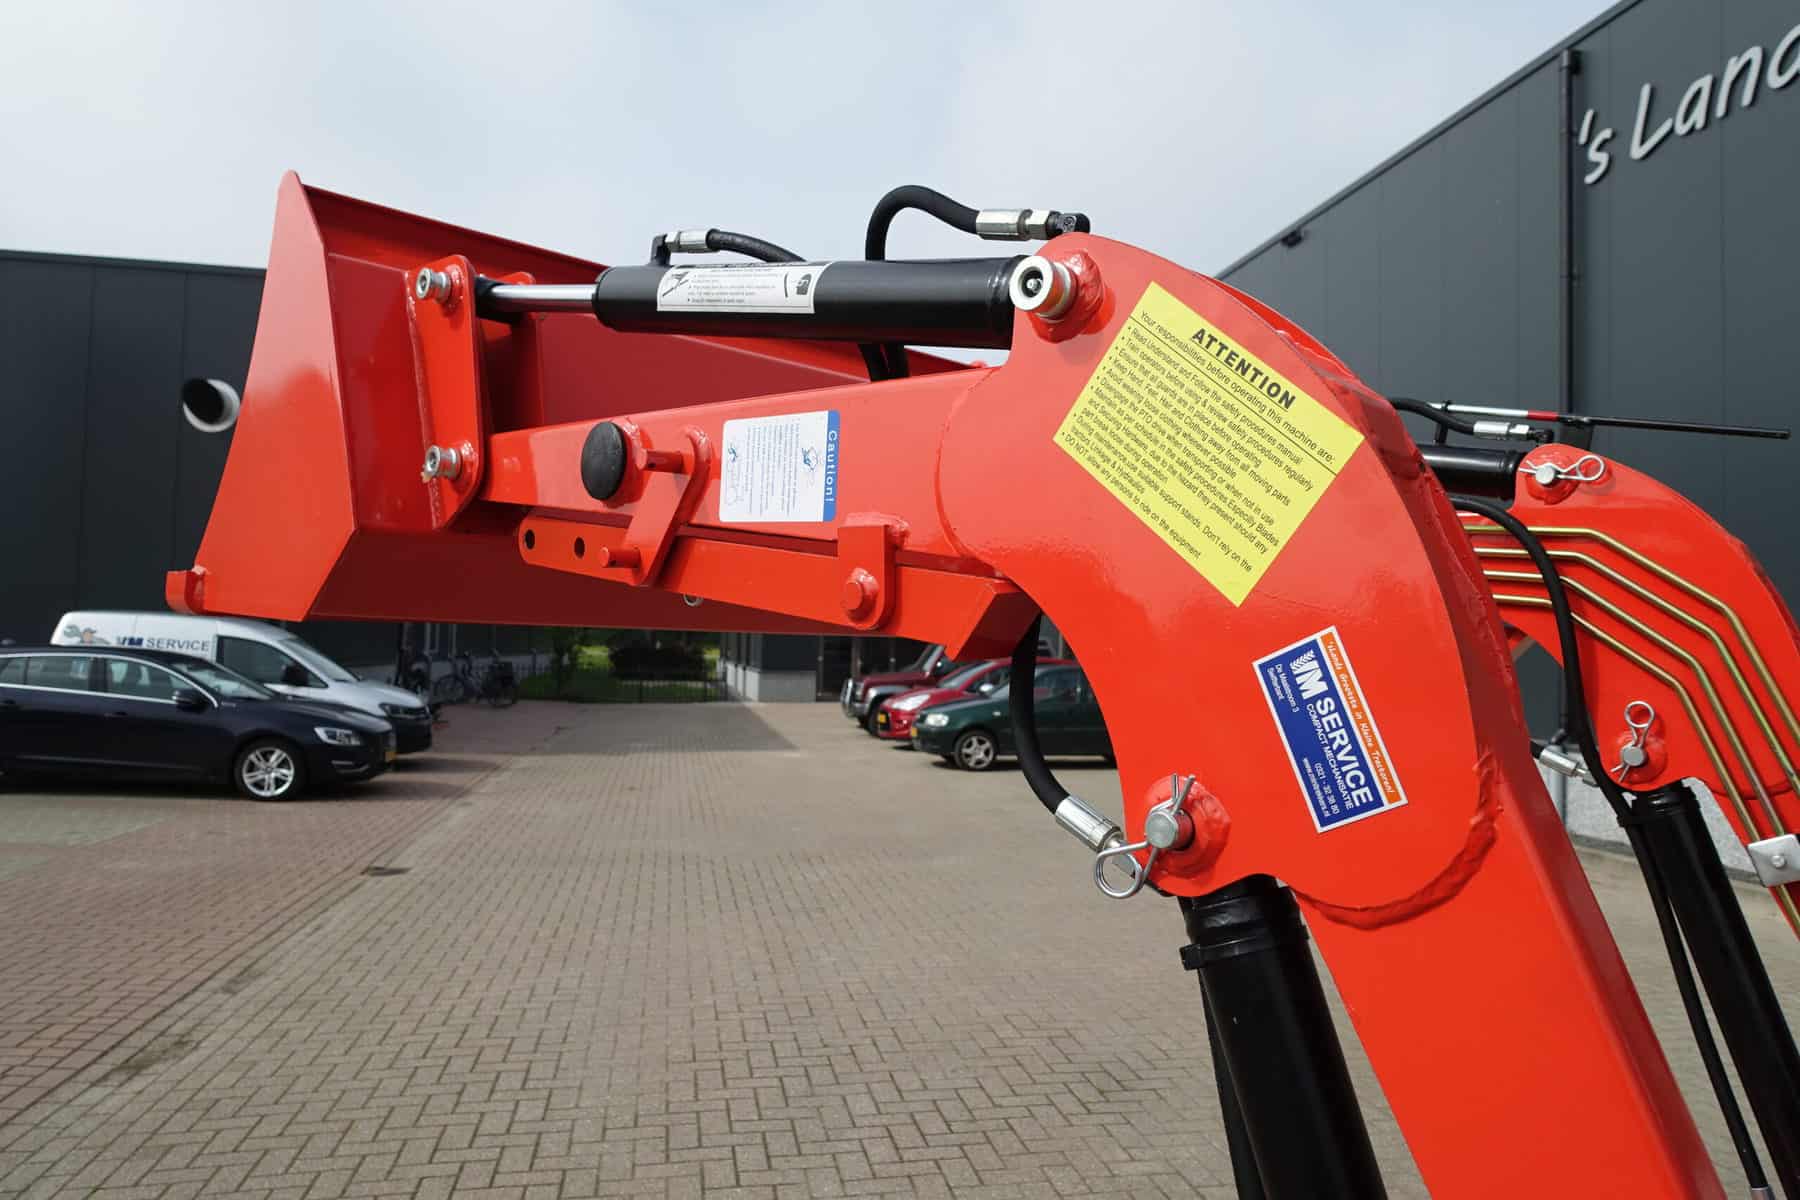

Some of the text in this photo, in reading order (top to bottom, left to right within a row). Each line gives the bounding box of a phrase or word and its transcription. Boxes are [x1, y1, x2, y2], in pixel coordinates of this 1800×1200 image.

[1578, 108, 1614, 185] 's
[1140, 310, 1156, 326] Your
[1155, 324, 1206, 366] responsibilities
[1205, 361, 1231, 384] before
[1230, 381, 1267, 414] operating
[1266, 408, 1282, 424] this
[1282, 421, 1317, 450] machine
[1192, 328, 1295, 409] ATTENTION
[1128, 401, 1139, 413] the
[1137, 408, 1153, 424] PTO
[1151, 421, 1166, 436] drive
[1182, 445, 1218, 480] transporting
[1241, 496, 1255, 509] not
[1260, 513, 1274, 526] use
[1139, 351, 1166, 375] operators
[1165, 371, 1185, 390] before
[1207, 404, 1228, 423] review
[1227, 420, 1248, 440] safety
[1245, 436, 1283, 468] procedures
[1283, 464, 1313, 492] regularly
[1143, 397, 1159, 415] loose
[1158, 412, 1182, 436] clothing
[1181, 431, 1211, 457] whenever
[1209, 454, 1237, 479] possible
[1149, 374, 1159, 383] all
[1155, 380, 1178, 400] guards
[1176, 396, 1188, 408] are
[1192, 409, 1212, 427] place
[1210, 421, 1232, 442] before
[1231, 439, 1262, 468] operating
[1171, 407, 1185, 420] and
[1183, 415, 1209, 442] Clothing
[1207, 437, 1226, 455] away
[1224, 448, 1241, 465] from
[1239, 462, 1250, 472] all
[1248, 469, 1273, 493] moving
[1270, 488, 1290, 506] parts
[1190, 374, 1211, 394] Follow
[1209, 389, 1222, 403] the
[1220, 399, 1242, 419] safety
[1239, 415, 1277, 446] procedures
[1276, 442, 1300, 464] manual
[825, 430, 838, 502] Caution!
[1074, 442, 1089, 456] NOT
[1100, 467, 1112, 480] any
[1158, 518, 1170, 531] the
[1169, 528, 1201, 559] equipment
[1140, 458, 1168, 483] operation
[1165, 447, 1176, 460] the
[1175, 457, 1195, 476] safety
[1255, 522, 1279, 546] Blades
[1158, 489, 1182, 511] support
[1201, 525, 1221, 544] Don't
[1218, 541, 1232, 555] rely
[1239, 559, 1252, 572] the
[1178, 472, 1199, 494] hazard
[1196, 489, 1211, 506] they
[1209, 502, 1235, 525] present
[1233, 521, 1257, 543] should
[1254, 540, 1268, 554] any
[146, 636, 210, 652] SERVICE
[1306, 703, 1354, 809] COMPACT MECHANISATIE
[1316, 697, 1373, 806] SERVICE
[1359, 722, 1373, 747] Kleine
